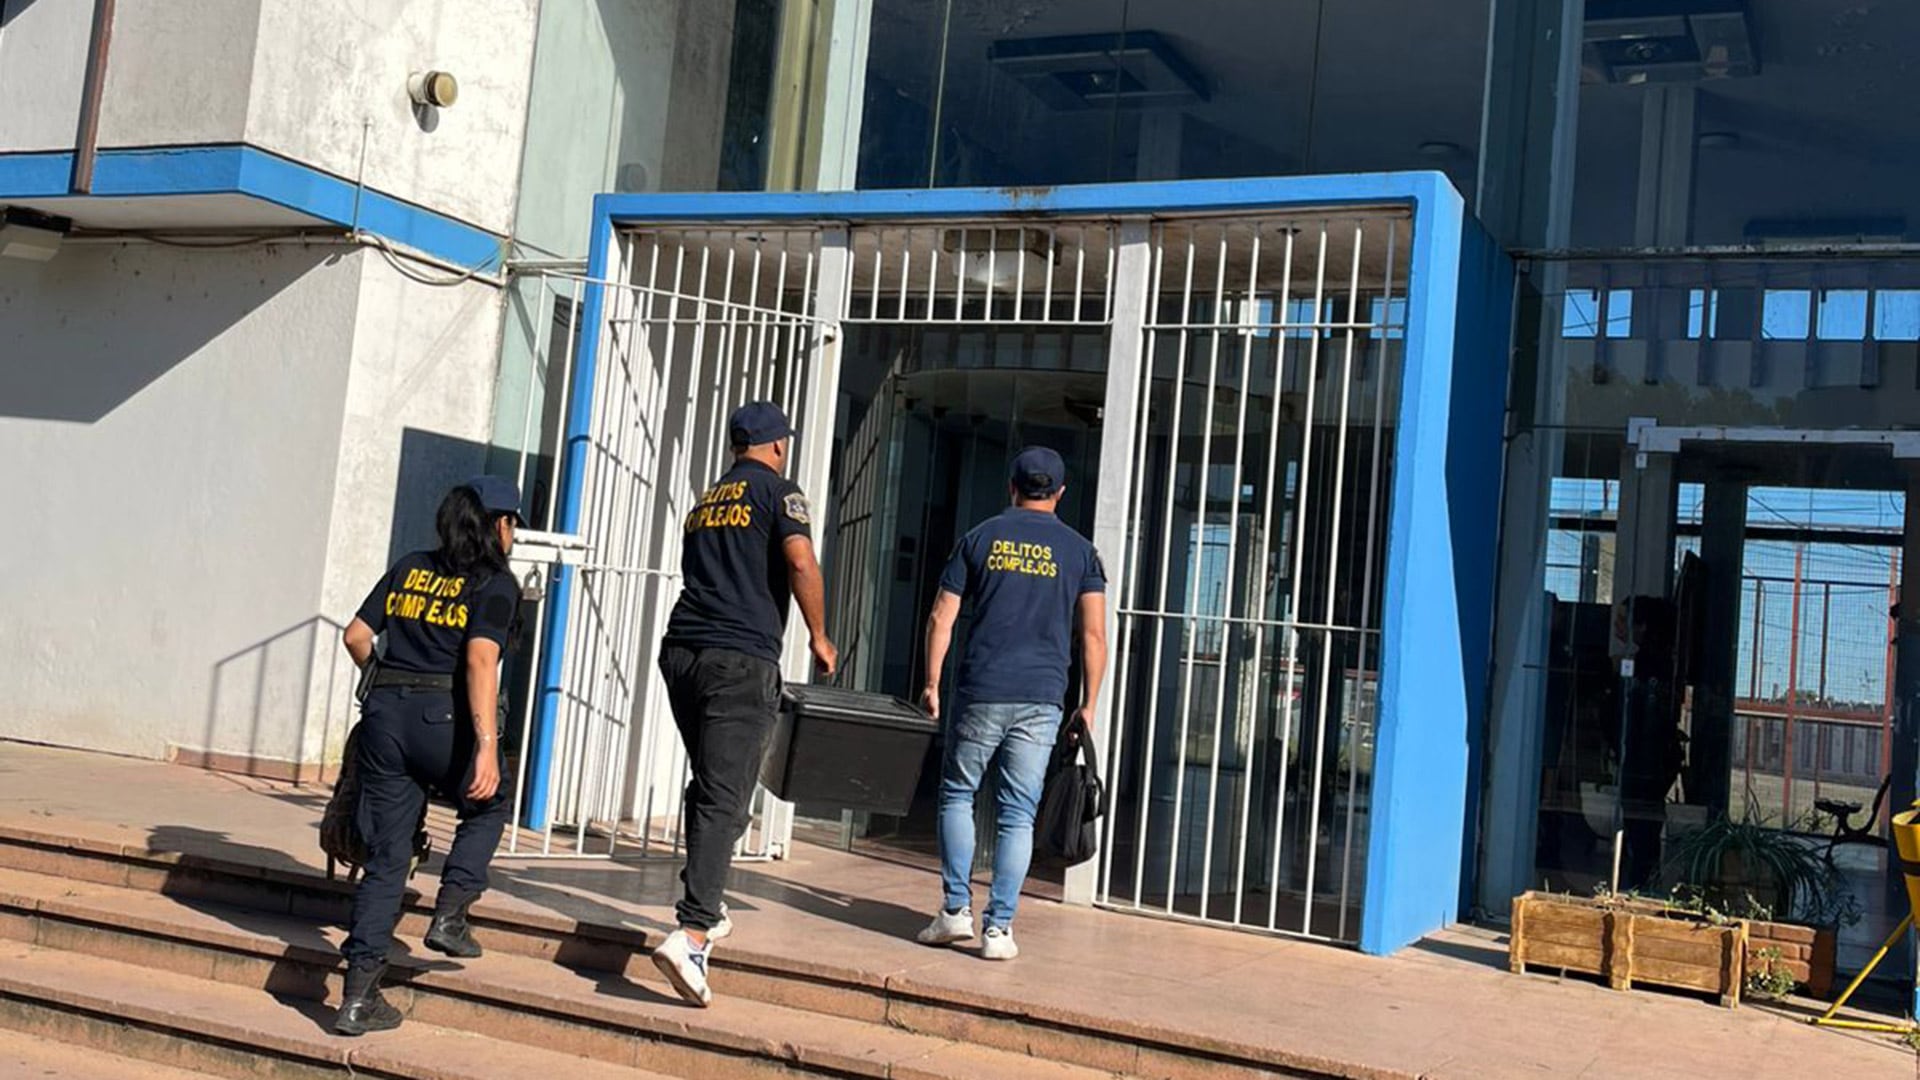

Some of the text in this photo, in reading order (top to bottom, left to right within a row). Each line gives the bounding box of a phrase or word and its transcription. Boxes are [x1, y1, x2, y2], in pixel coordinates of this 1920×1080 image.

[701, 481, 747, 504] ELITOS
[993, 540, 1052, 560] DELITOS
[987, 555, 1057, 577] COMPLEJOS
[404, 568, 464, 597] DELITOS
[386, 592, 468, 628] COMPEJOS
